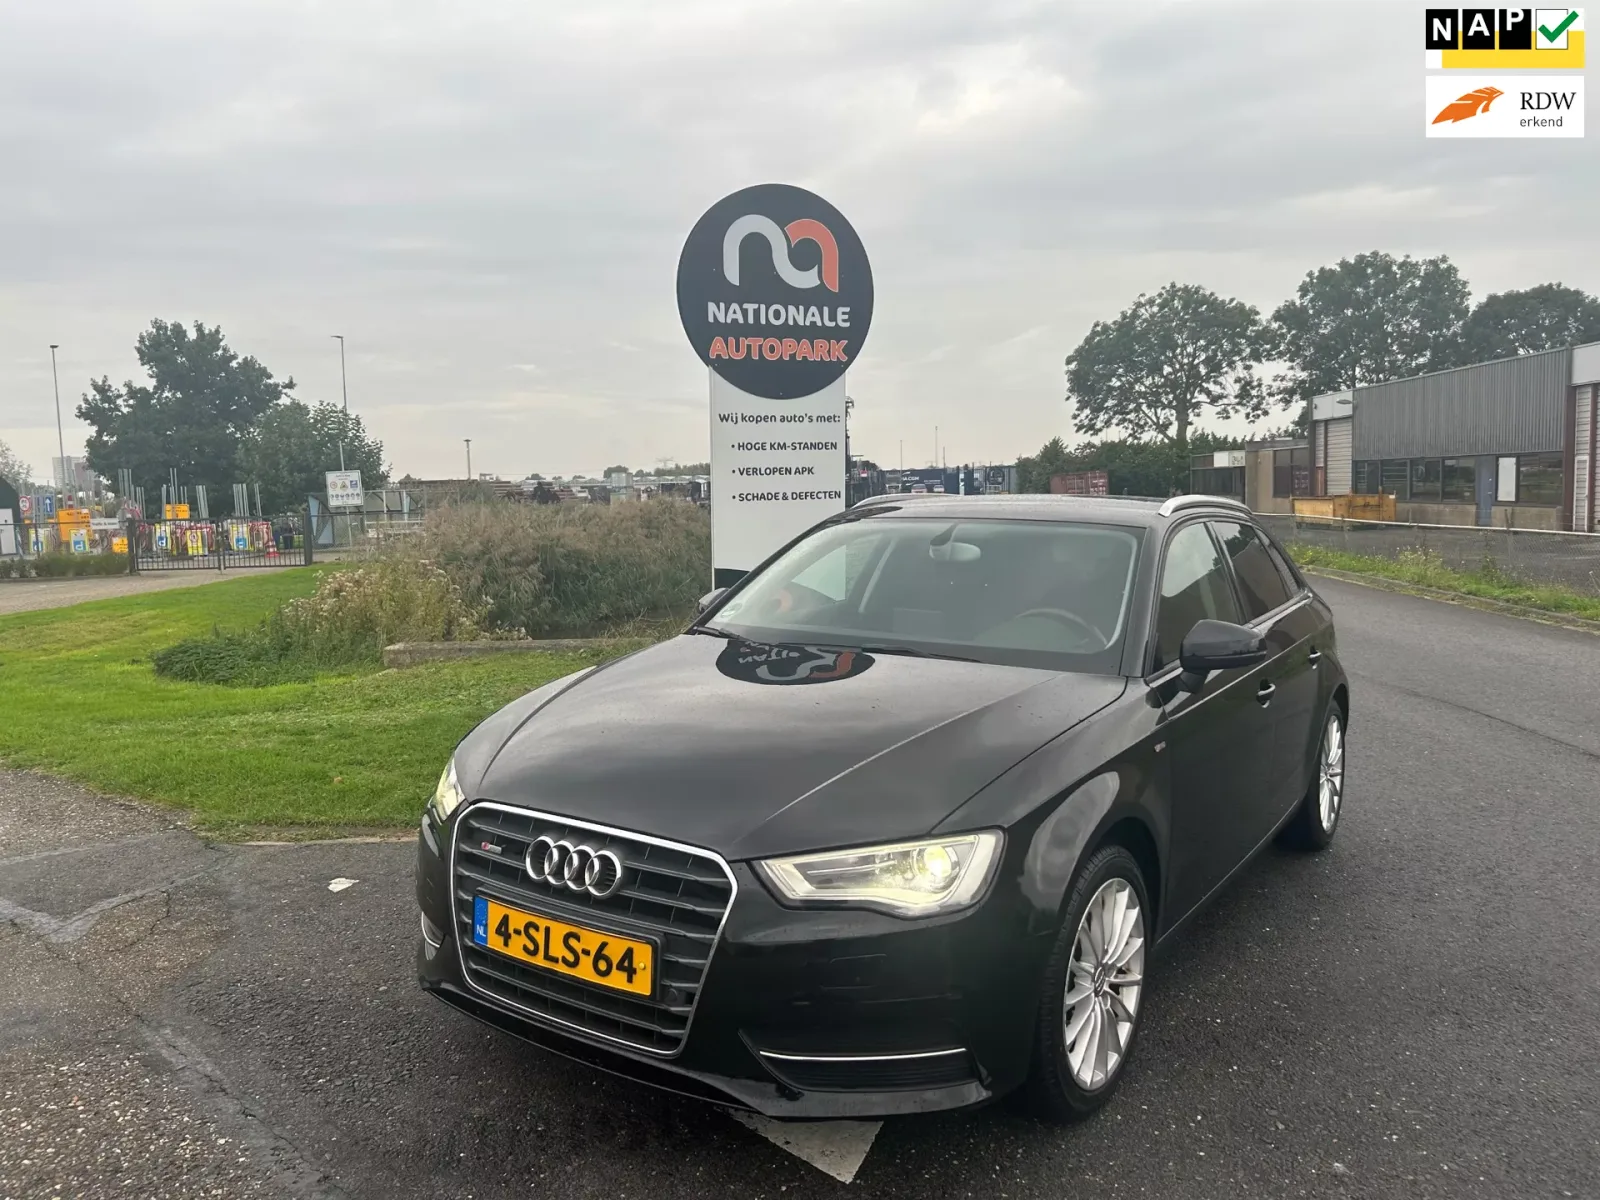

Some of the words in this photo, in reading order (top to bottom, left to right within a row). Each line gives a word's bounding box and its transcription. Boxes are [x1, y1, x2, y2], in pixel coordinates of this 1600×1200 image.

[707, 301, 851, 328] NATIONALE
[709, 336, 848, 361] AUTOPARK
[718, 412, 738, 425] Wij
[741, 413, 777, 425] kopen
[779, 413, 814, 423] auto's
[816, 413, 841, 423] met:
[737, 442, 767, 451] HOGE
[769, 441, 838, 451] KM-STANDEN
[738, 467, 792, 476] VERLOPEN
[794, 466, 815, 476] APK
[738, 491, 780, 502] SCHADE
[781, 491, 789, 501] &
[791, 490, 841, 500] DEFECTEN
[476, 924, 487, 937] NL
[494, 913, 638, 984] 4-SLS-64
